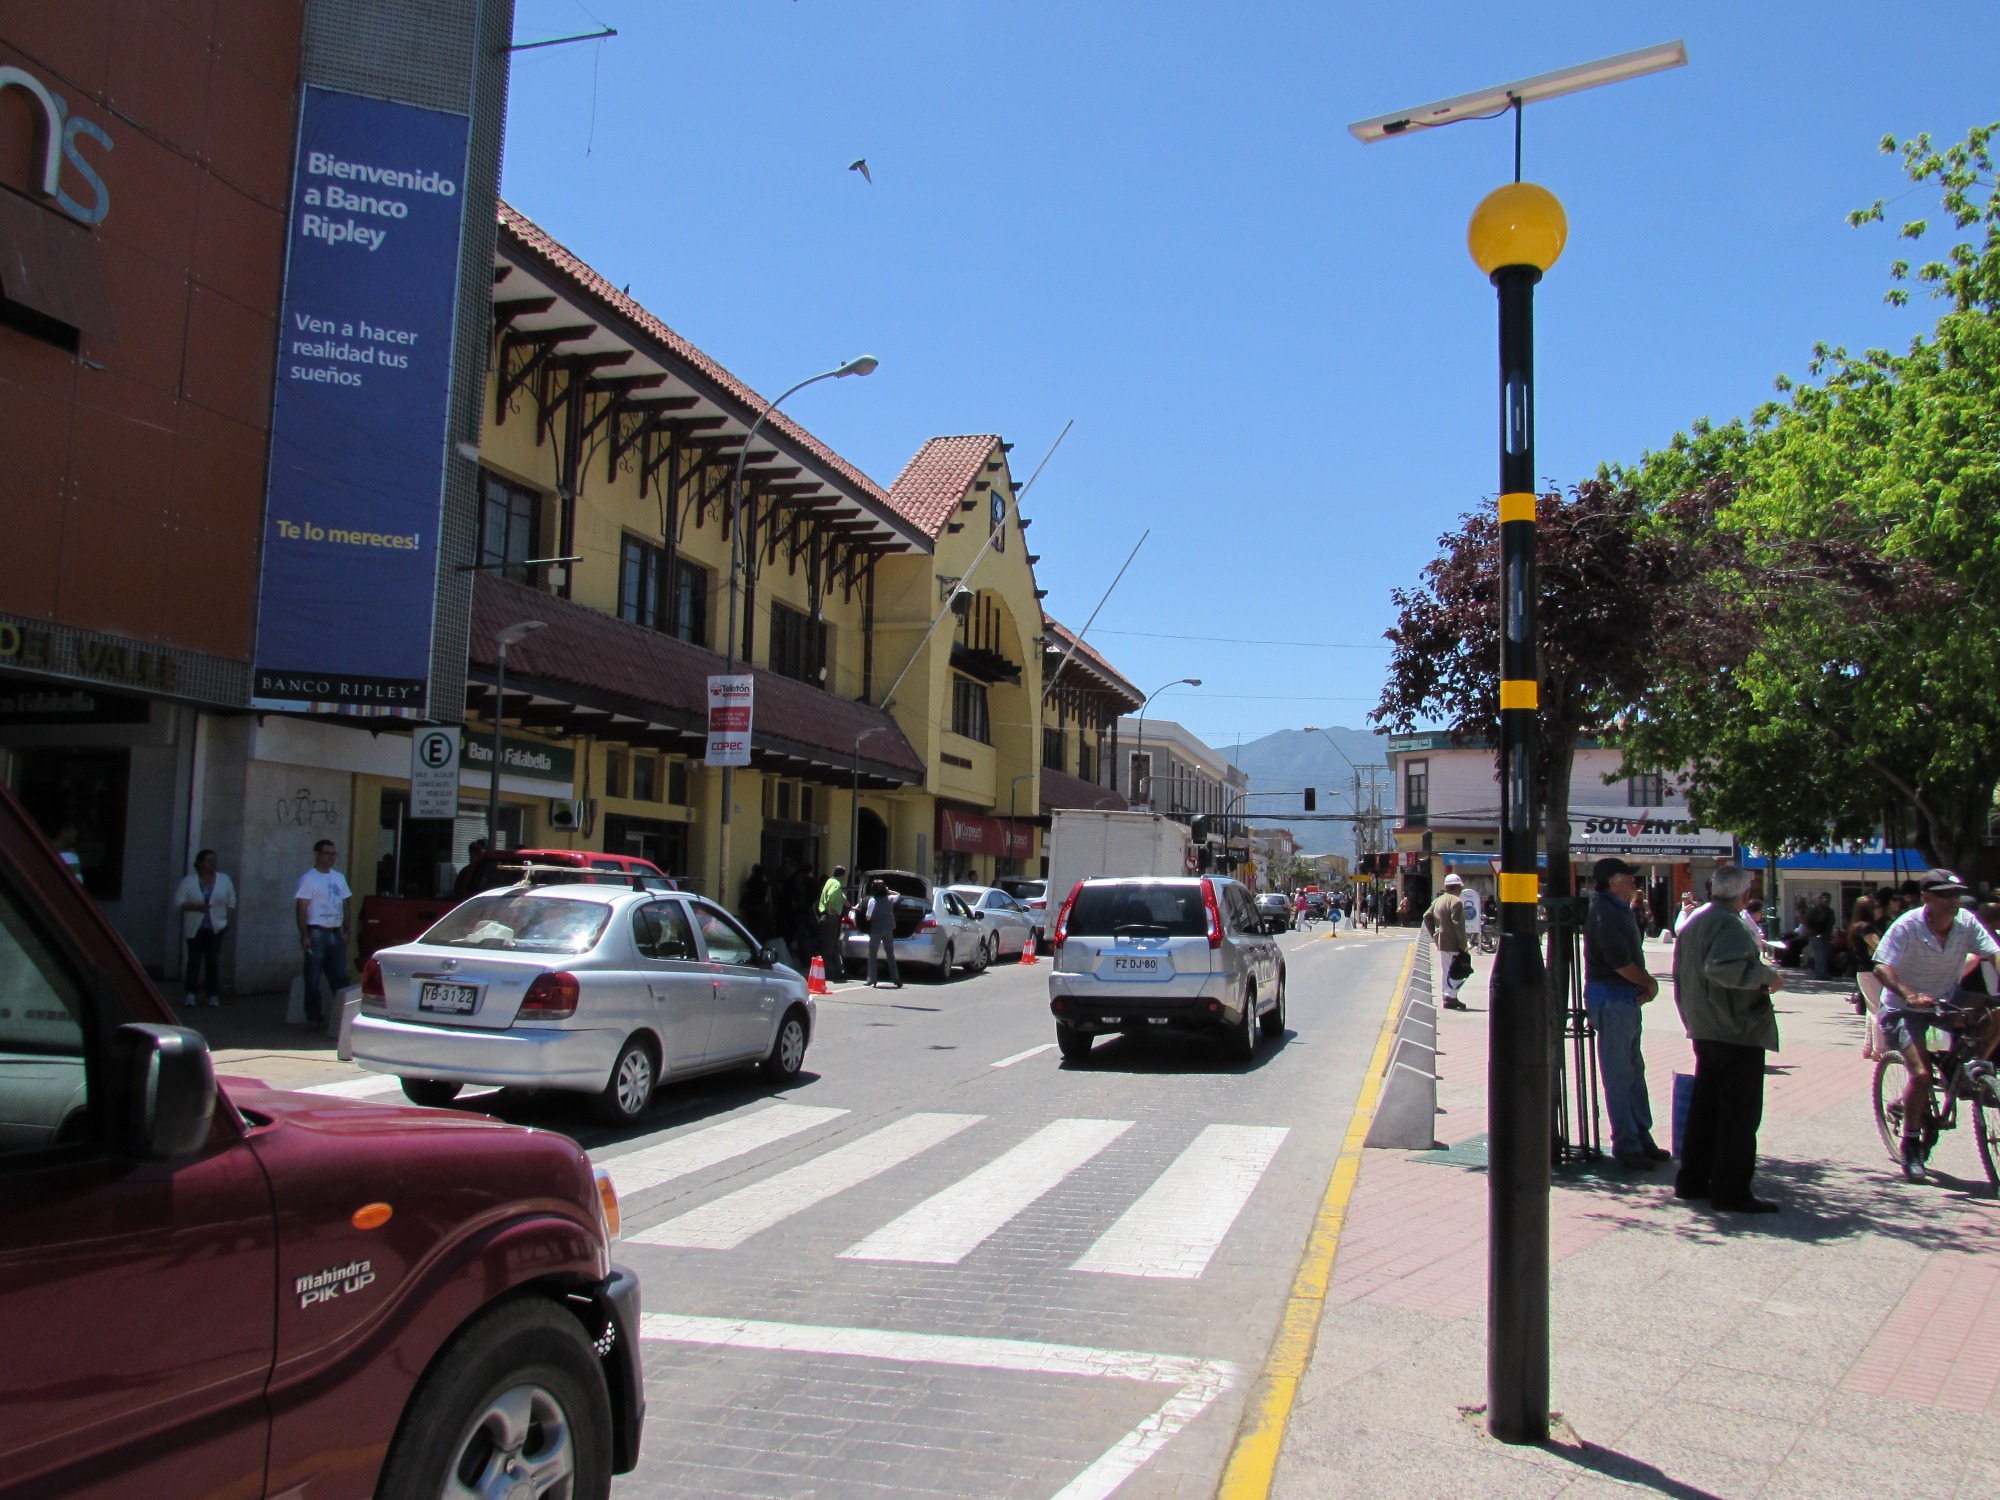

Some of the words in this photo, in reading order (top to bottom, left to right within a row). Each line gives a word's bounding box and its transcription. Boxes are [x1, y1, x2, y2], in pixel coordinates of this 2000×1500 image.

[308, 152, 456, 196] Bienvenido
[304, 188, 321, 206] a
[326, 186, 408, 219] Banco
[303, 214, 387, 251] Ripley
[295, 312, 336, 335] Ven
[341, 323, 353, 337] a
[359, 321, 418, 345] hacer
[293, 340, 374, 364] realidad
[378, 350, 408, 368] tus
[291, 366, 362, 387] sueños
[277, 520, 301, 539] Te
[304, 521, 325, 541] lo
[328, 529, 420, 550] mereces!
[80, 638, 184, 687] VALLE
[262, 677, 330, 693] BANCO
[340, 683, 410, 698] RIPLEY
[722, 684, 750, 693] Teletón
[429, 739, 443, 762] E
[504, 748, 551, 770] Falabella
[961, 822, 982, 840] Coopeuch
[1115, 958, 1127, 968] FZ
[296, 1260, 371, 1294] Mahindra
[301, 1282, 339, 1309] PIK
[344, 1272, 376, 1294] UP
